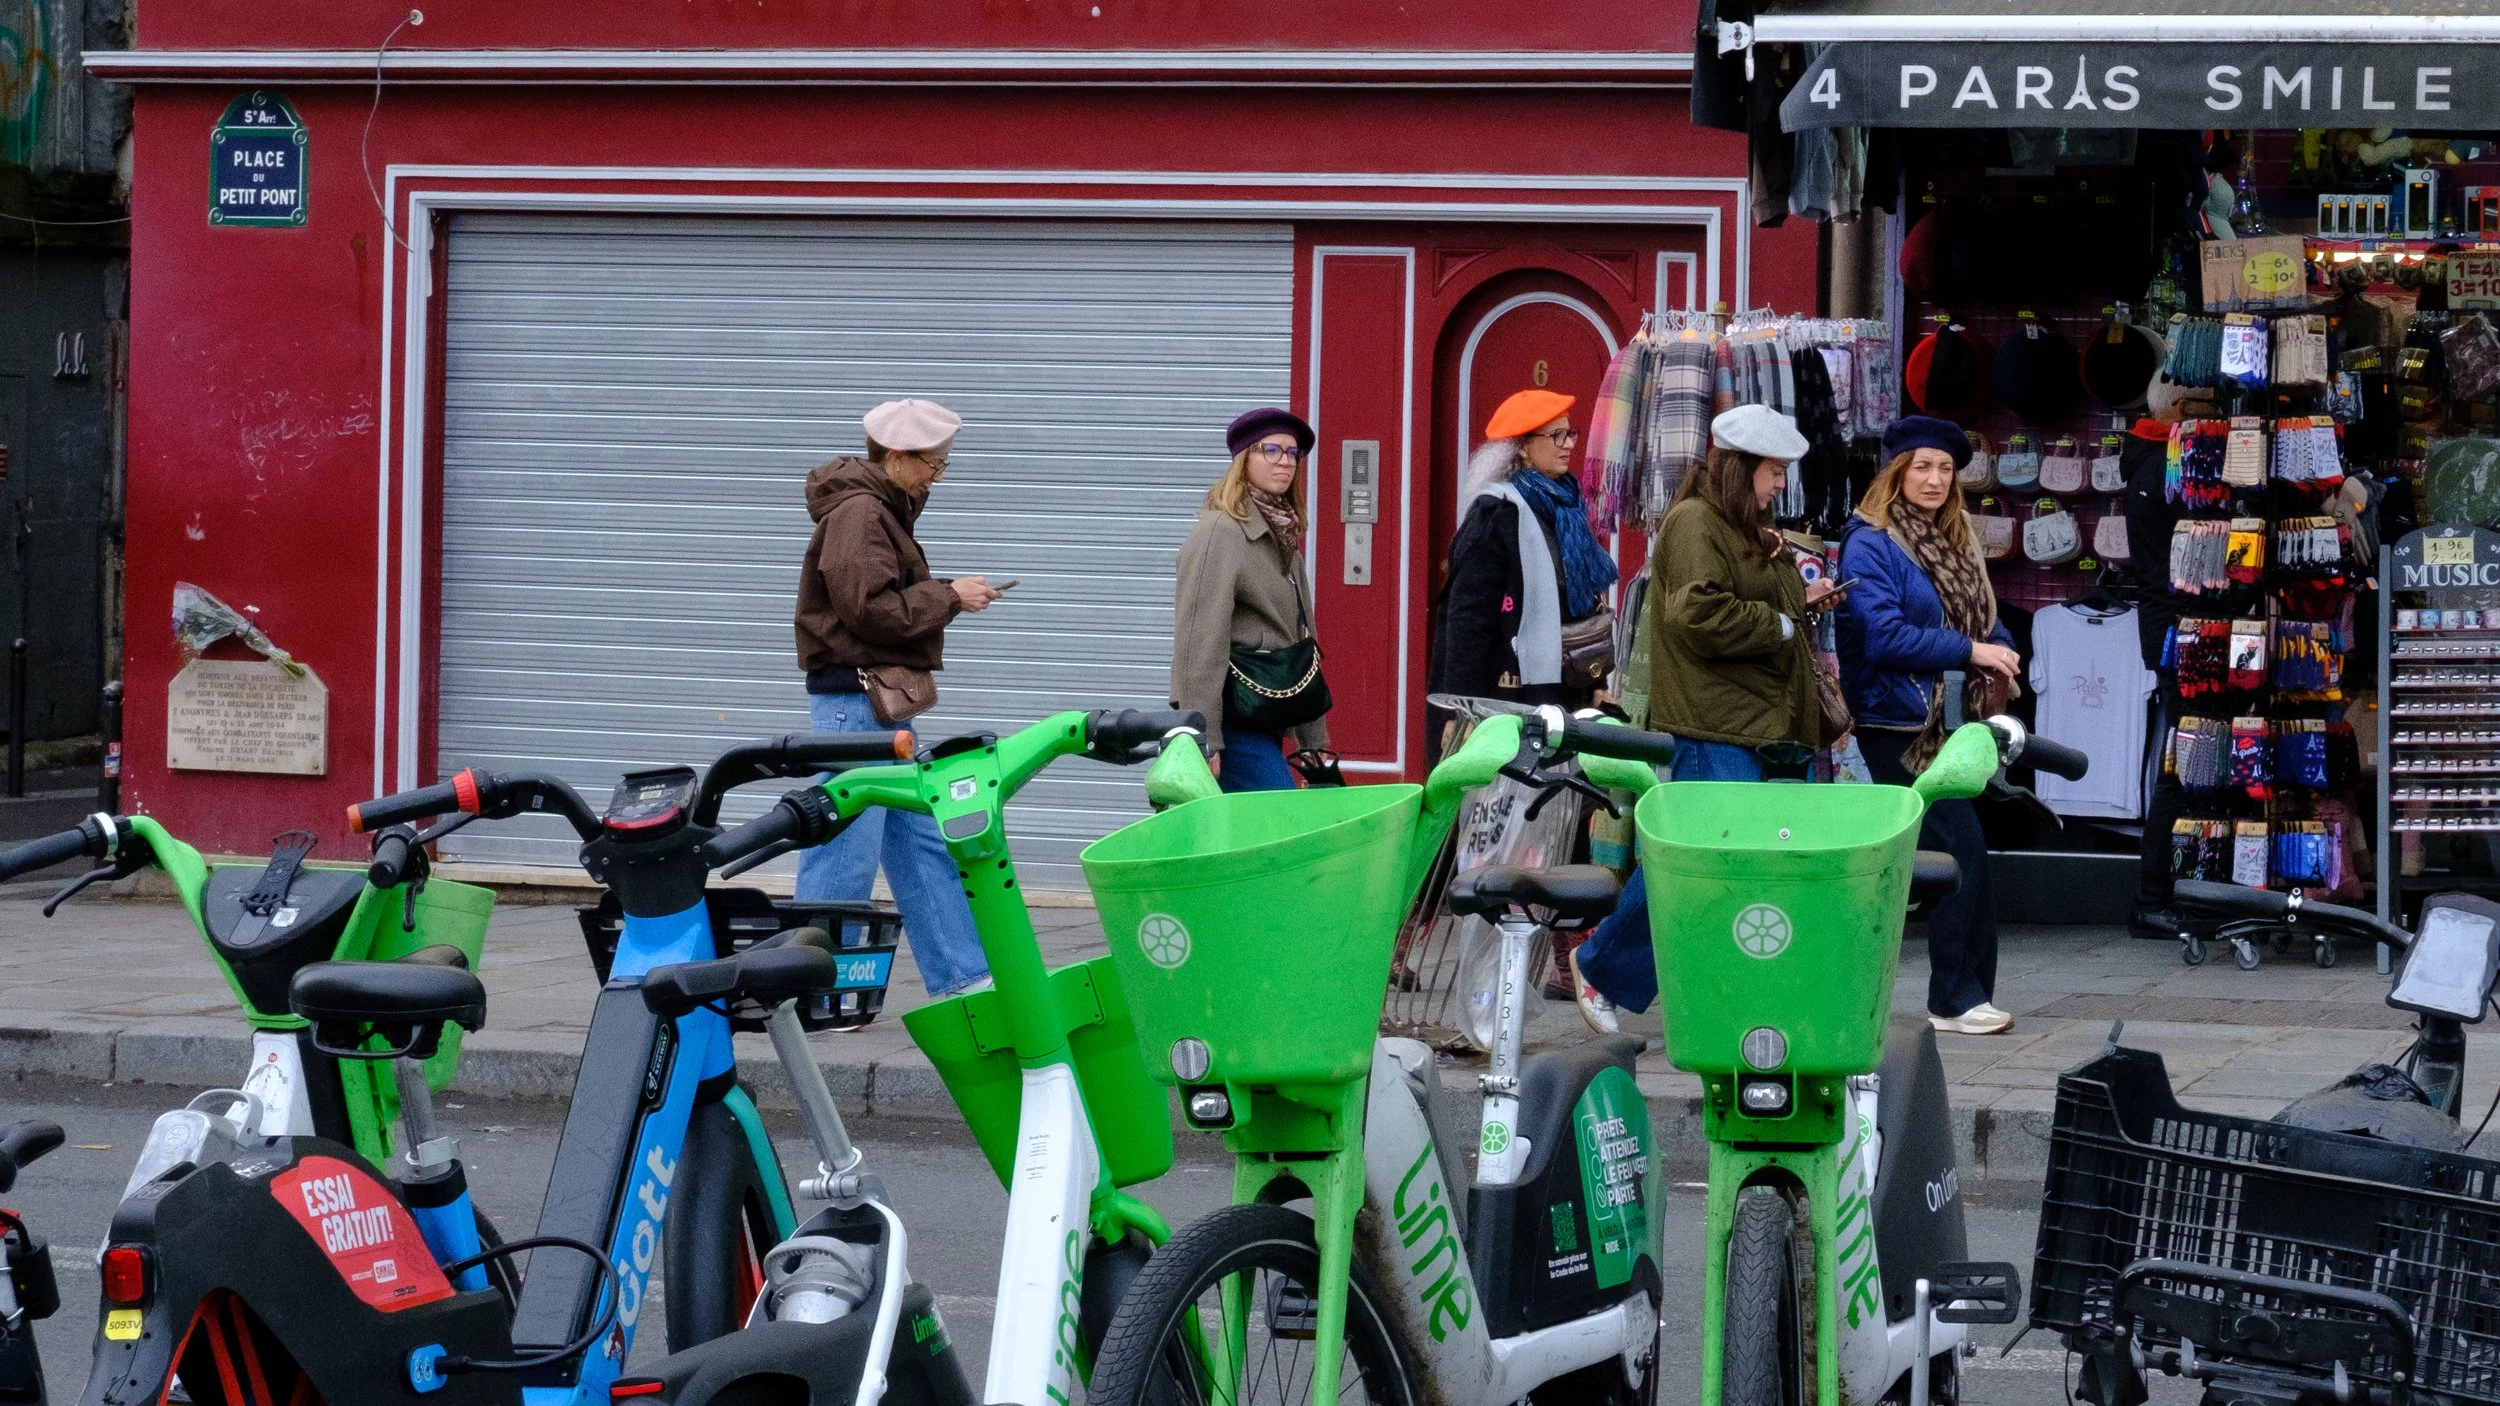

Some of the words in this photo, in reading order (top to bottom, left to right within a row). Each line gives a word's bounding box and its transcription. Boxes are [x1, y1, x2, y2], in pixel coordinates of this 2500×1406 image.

[1810, 68, 1841, 110] 4
[1899, 54, 2141, 111] PARIS
[2204, 65, 2453, 112] SMILE
[233, 150, 285, 167] PLACE
[252, 173, 265, 183] DU
[220, 188, 257, 205] PETIT
[260, 189, 297, 205] PONT
[1533, 359, 1549, 388] 6
[2071, 675, 2109, 694] Paris
[848, 959, 877, 982] dott
[1507, 959, 1512, 971] 1
[1504, 982, 1513, 995] 2
[1502, 1006, 1511, 1019] 3
[1499, 1030, 1508, 1043] 4
[1497, 1054, 1506, 1067] 5
[1603, 1165, 1617, 1186] LE
[301, 1173, 356, 1218] ESSAI
[1607, 1184, 1637, 1208] PARTE
[1925, 1180, 1945, 1213] On
[321, 1205, 395, 1254] GRATUIT!
[1393, 1138, 1473, 1344] Lime
[108, 1320, 142, 1330] 5093V
